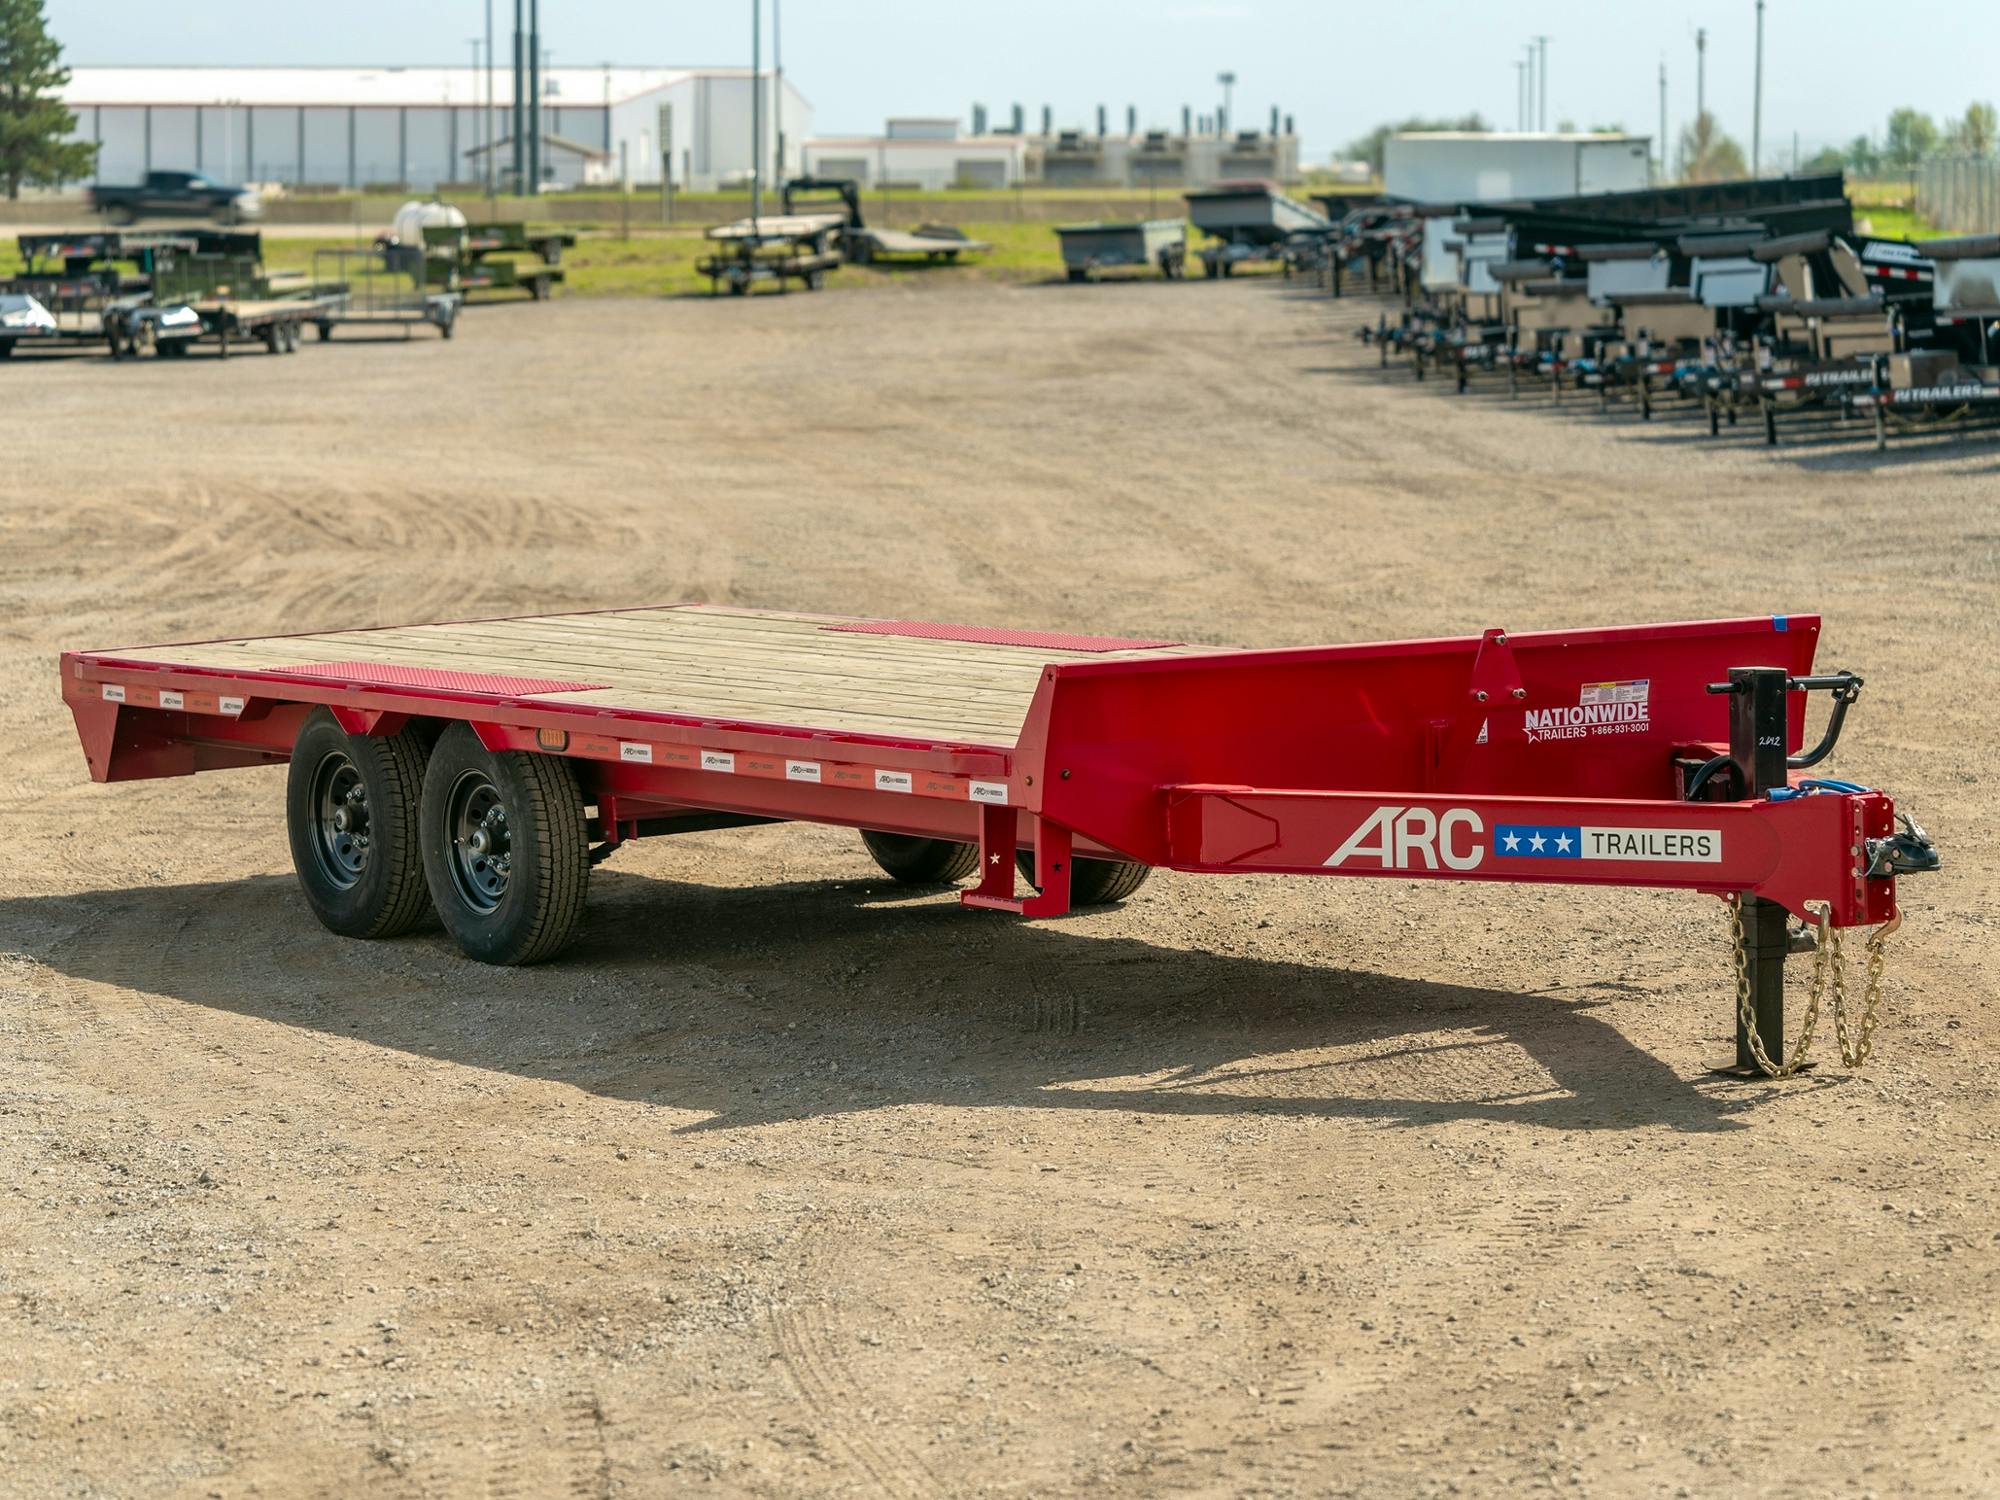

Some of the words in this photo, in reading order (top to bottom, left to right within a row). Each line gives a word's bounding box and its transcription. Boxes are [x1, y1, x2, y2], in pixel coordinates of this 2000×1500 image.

[1910, 384, 1983, 401] TRAILERS
[1525, 701, 1649, 728] NATIONWIDE
[1537, 726, 1588, 741] TRAILERS
[1591, 722, 1649, 736] 1-866-931-3001
[1322, 806, 1485, 871] ARC
[1591, 832, 1712, 857] TRAILERS
